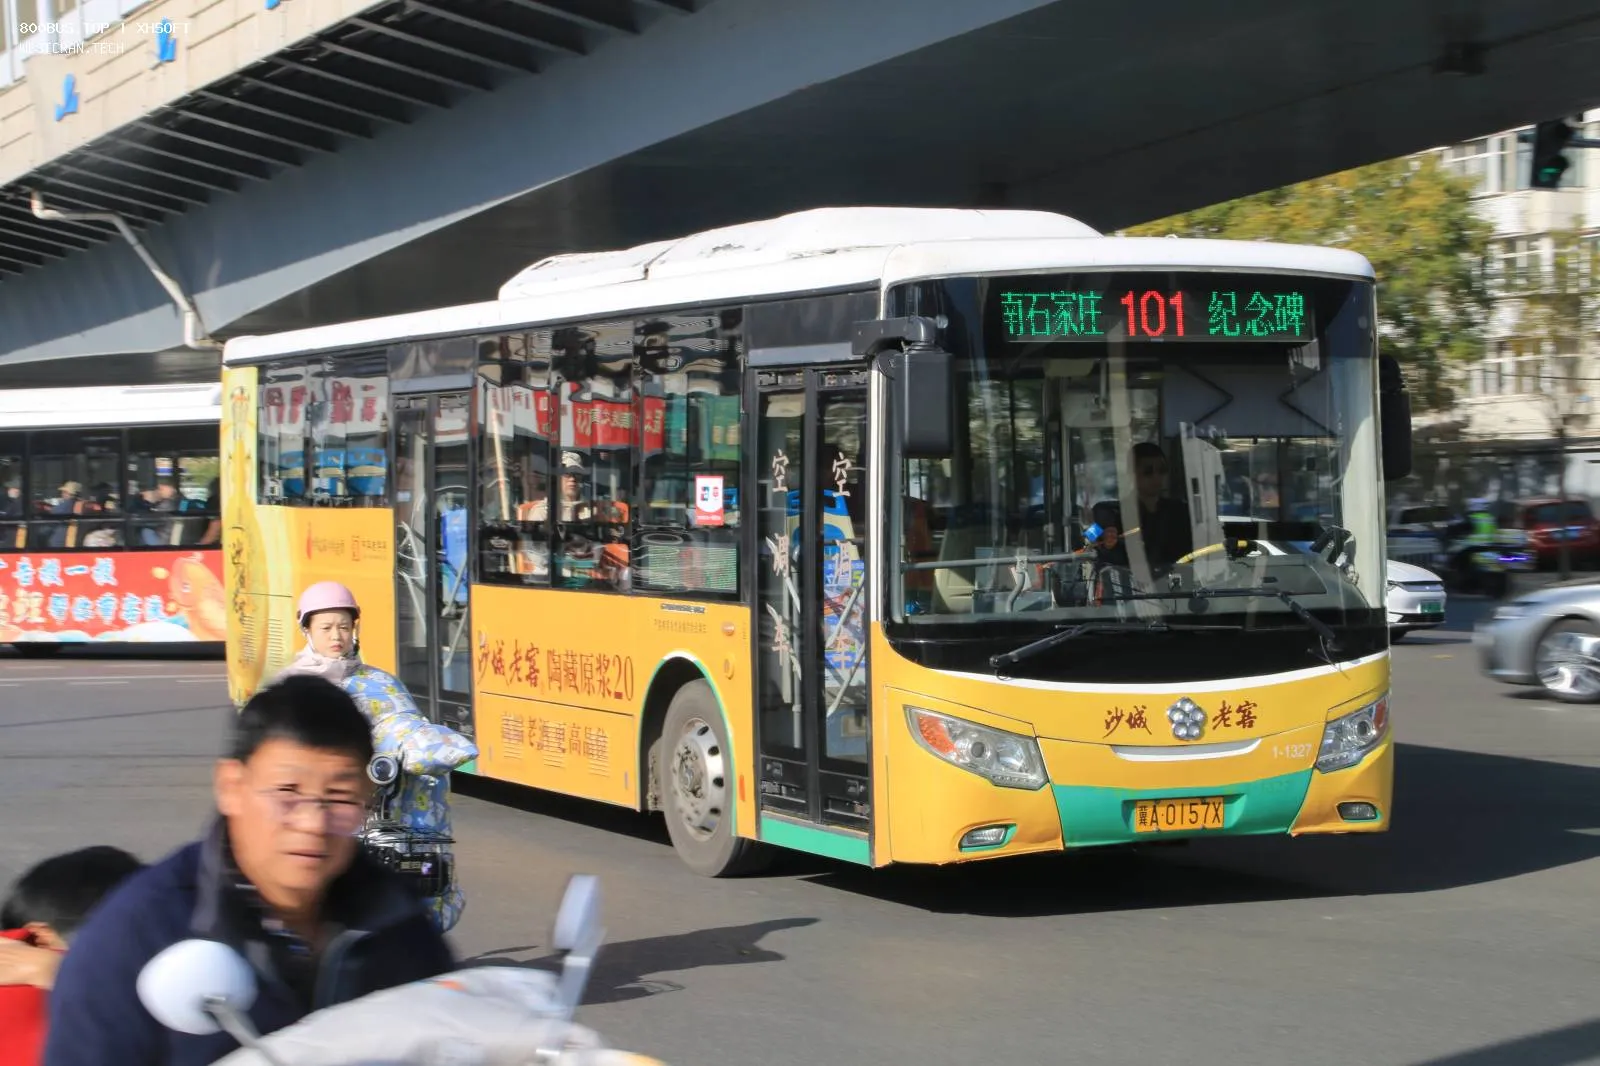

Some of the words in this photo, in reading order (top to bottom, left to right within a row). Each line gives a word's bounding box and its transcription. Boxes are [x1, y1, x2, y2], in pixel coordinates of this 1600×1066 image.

[1120, 290, 1184, 337] 101
[1208, 291, 1304, 337] 纪念碑
[1102, 704, 1153, 739] 沙城
[1212, 700, 1258, 731] 老窖
[1272, 743, 1312, 759] 1-1327
